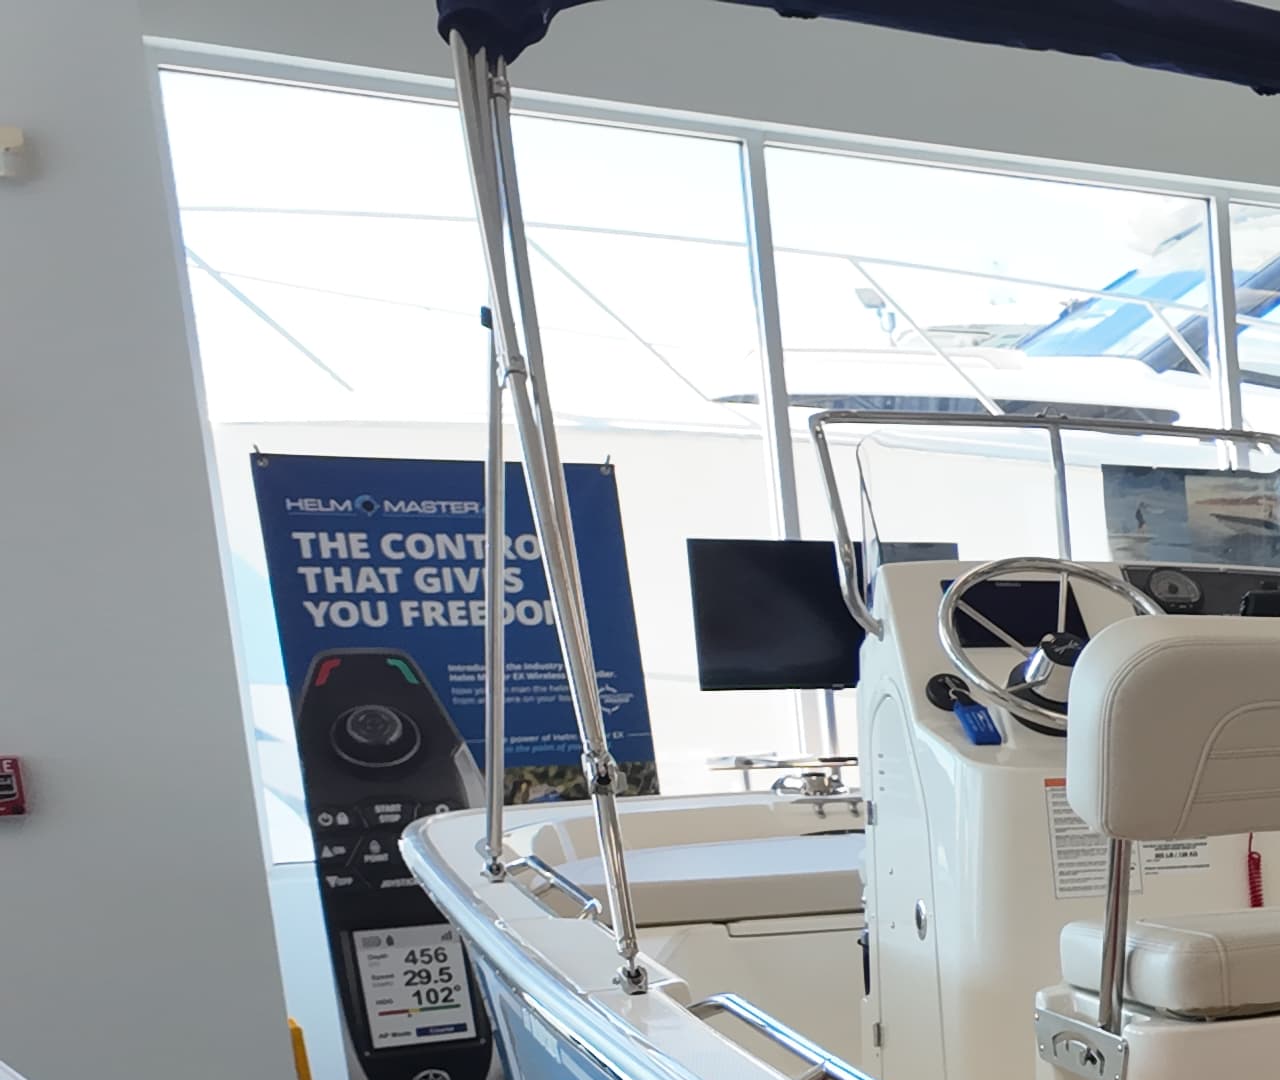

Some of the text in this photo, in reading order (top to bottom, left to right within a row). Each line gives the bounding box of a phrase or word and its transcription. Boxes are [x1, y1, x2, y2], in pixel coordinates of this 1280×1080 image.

[285, 497, 480, 514] HELM MASTER
[291, 531, 542, 561] THE CONTRO
[297, 566, 524, 594] THAT GIVS
[302, 600, 556, 628] YOU FREEO
[404, 946, 448, 965] 456
[403, 966, 453, 987] 29.5
